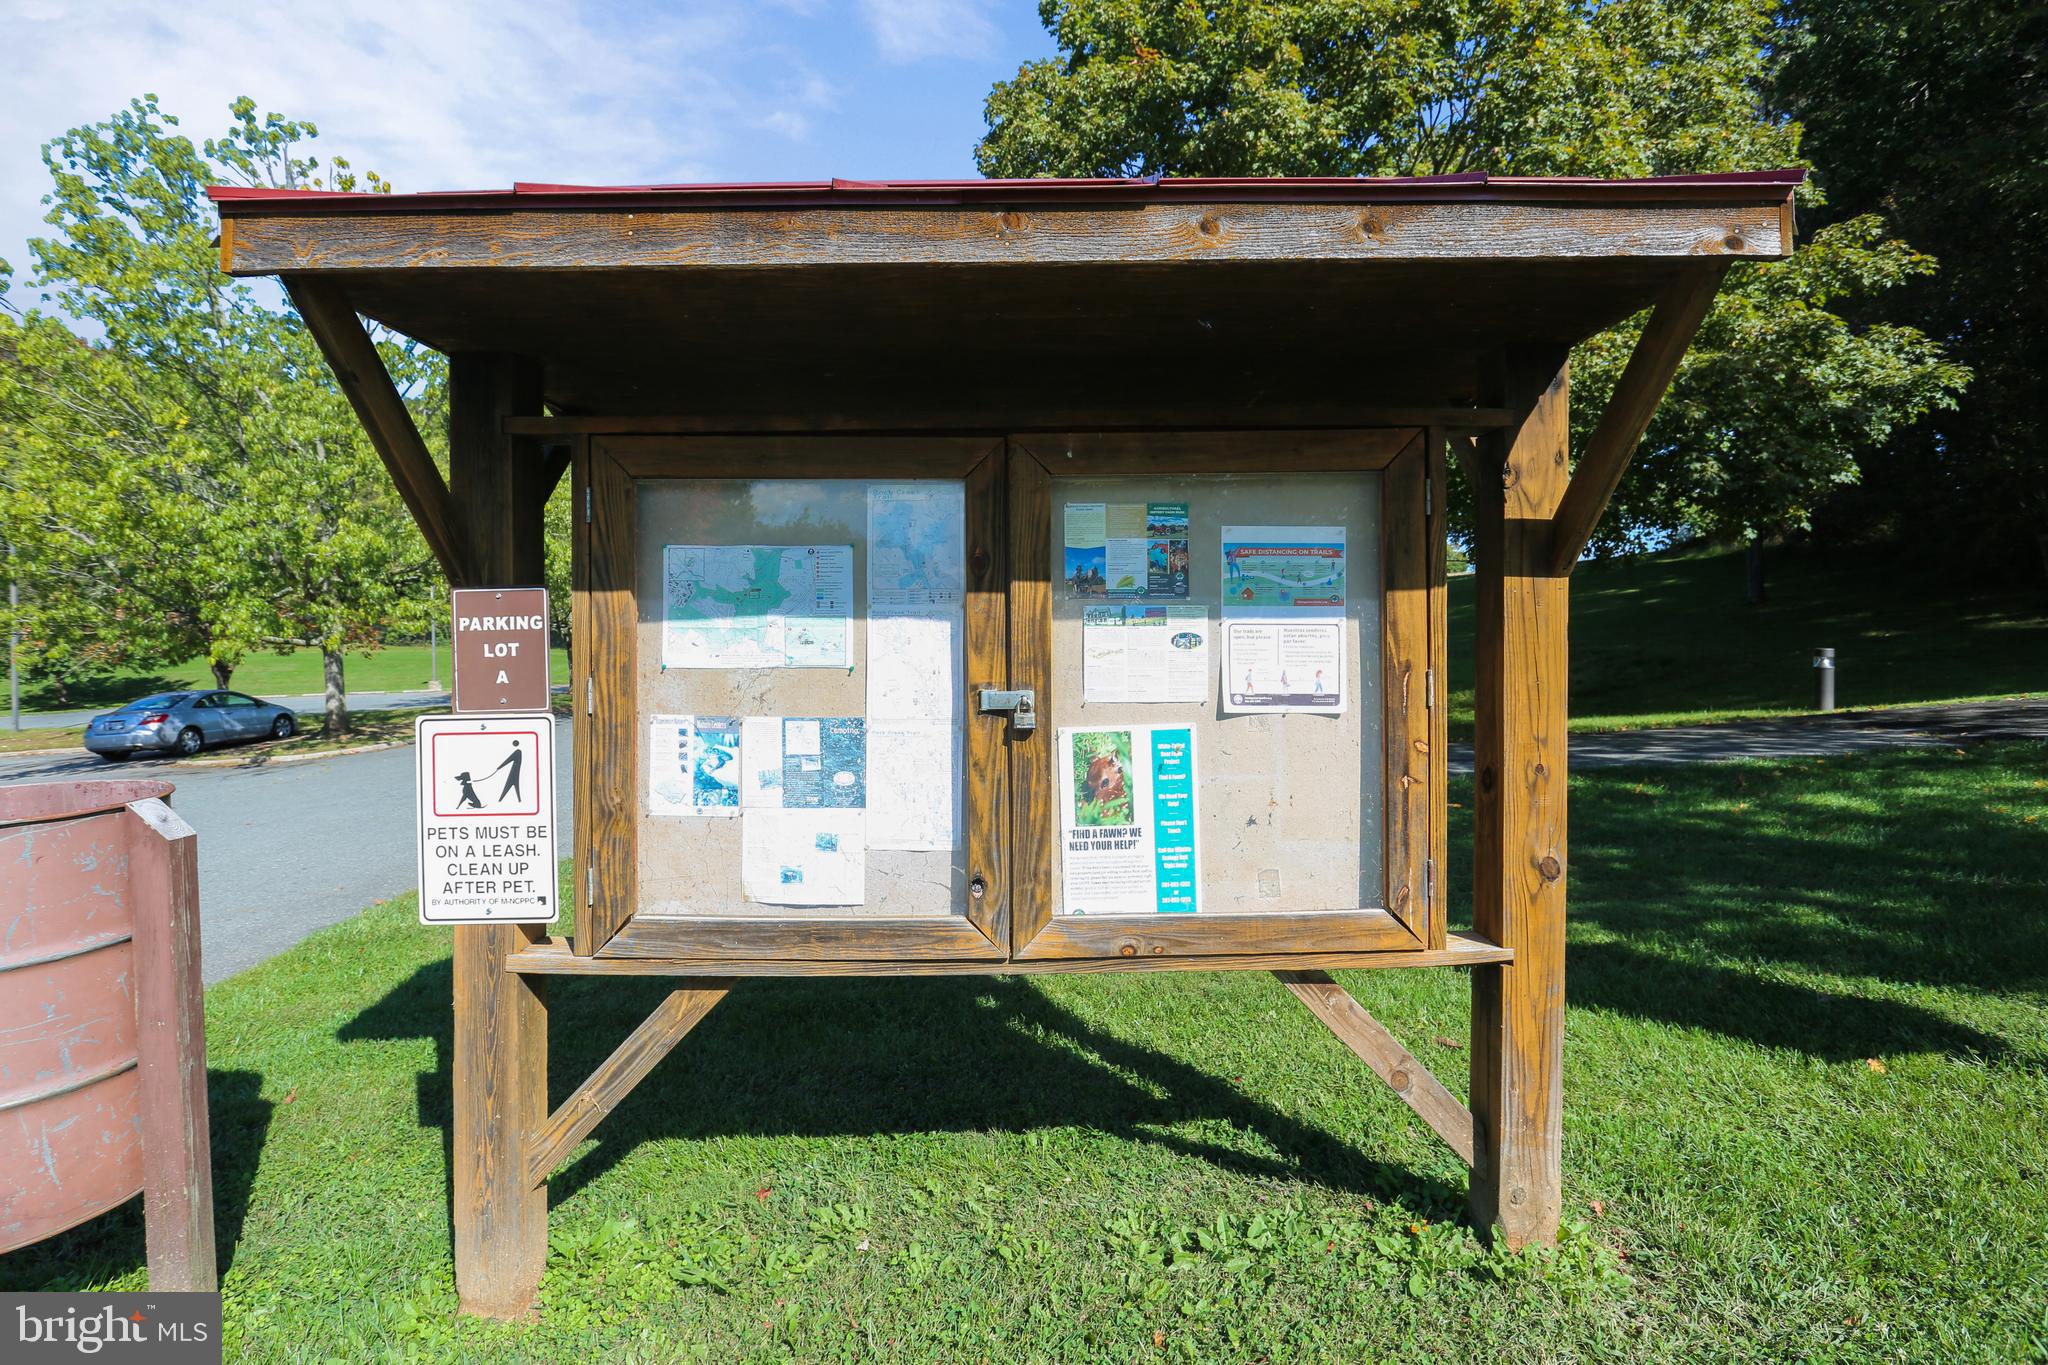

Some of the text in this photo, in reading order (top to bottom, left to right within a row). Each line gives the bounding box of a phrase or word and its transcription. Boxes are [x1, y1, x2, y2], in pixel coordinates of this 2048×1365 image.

[459, 615, 543, 631] PARKING
[484, 643, 519, 657] LOT
[496, 670, 509, 684] A
[427, 825, 547, 840] PETS MUST BE
[1092, 829, 1098, 838] A
[1100, 828, 1127, 838] FAWN?
[1129, 827, 1142, 838] WE
[435, 843, 540, 858] ON A LEASH.
[1069, 841, 1089, 851] NEED
[1090, 840, 1112, 851] YOUR
[447, 862, 529, 876] CLEAN UP
[443, 880, 536, 894] AFTER PET.
[501, 897, 535, 905] M-NCPPC
